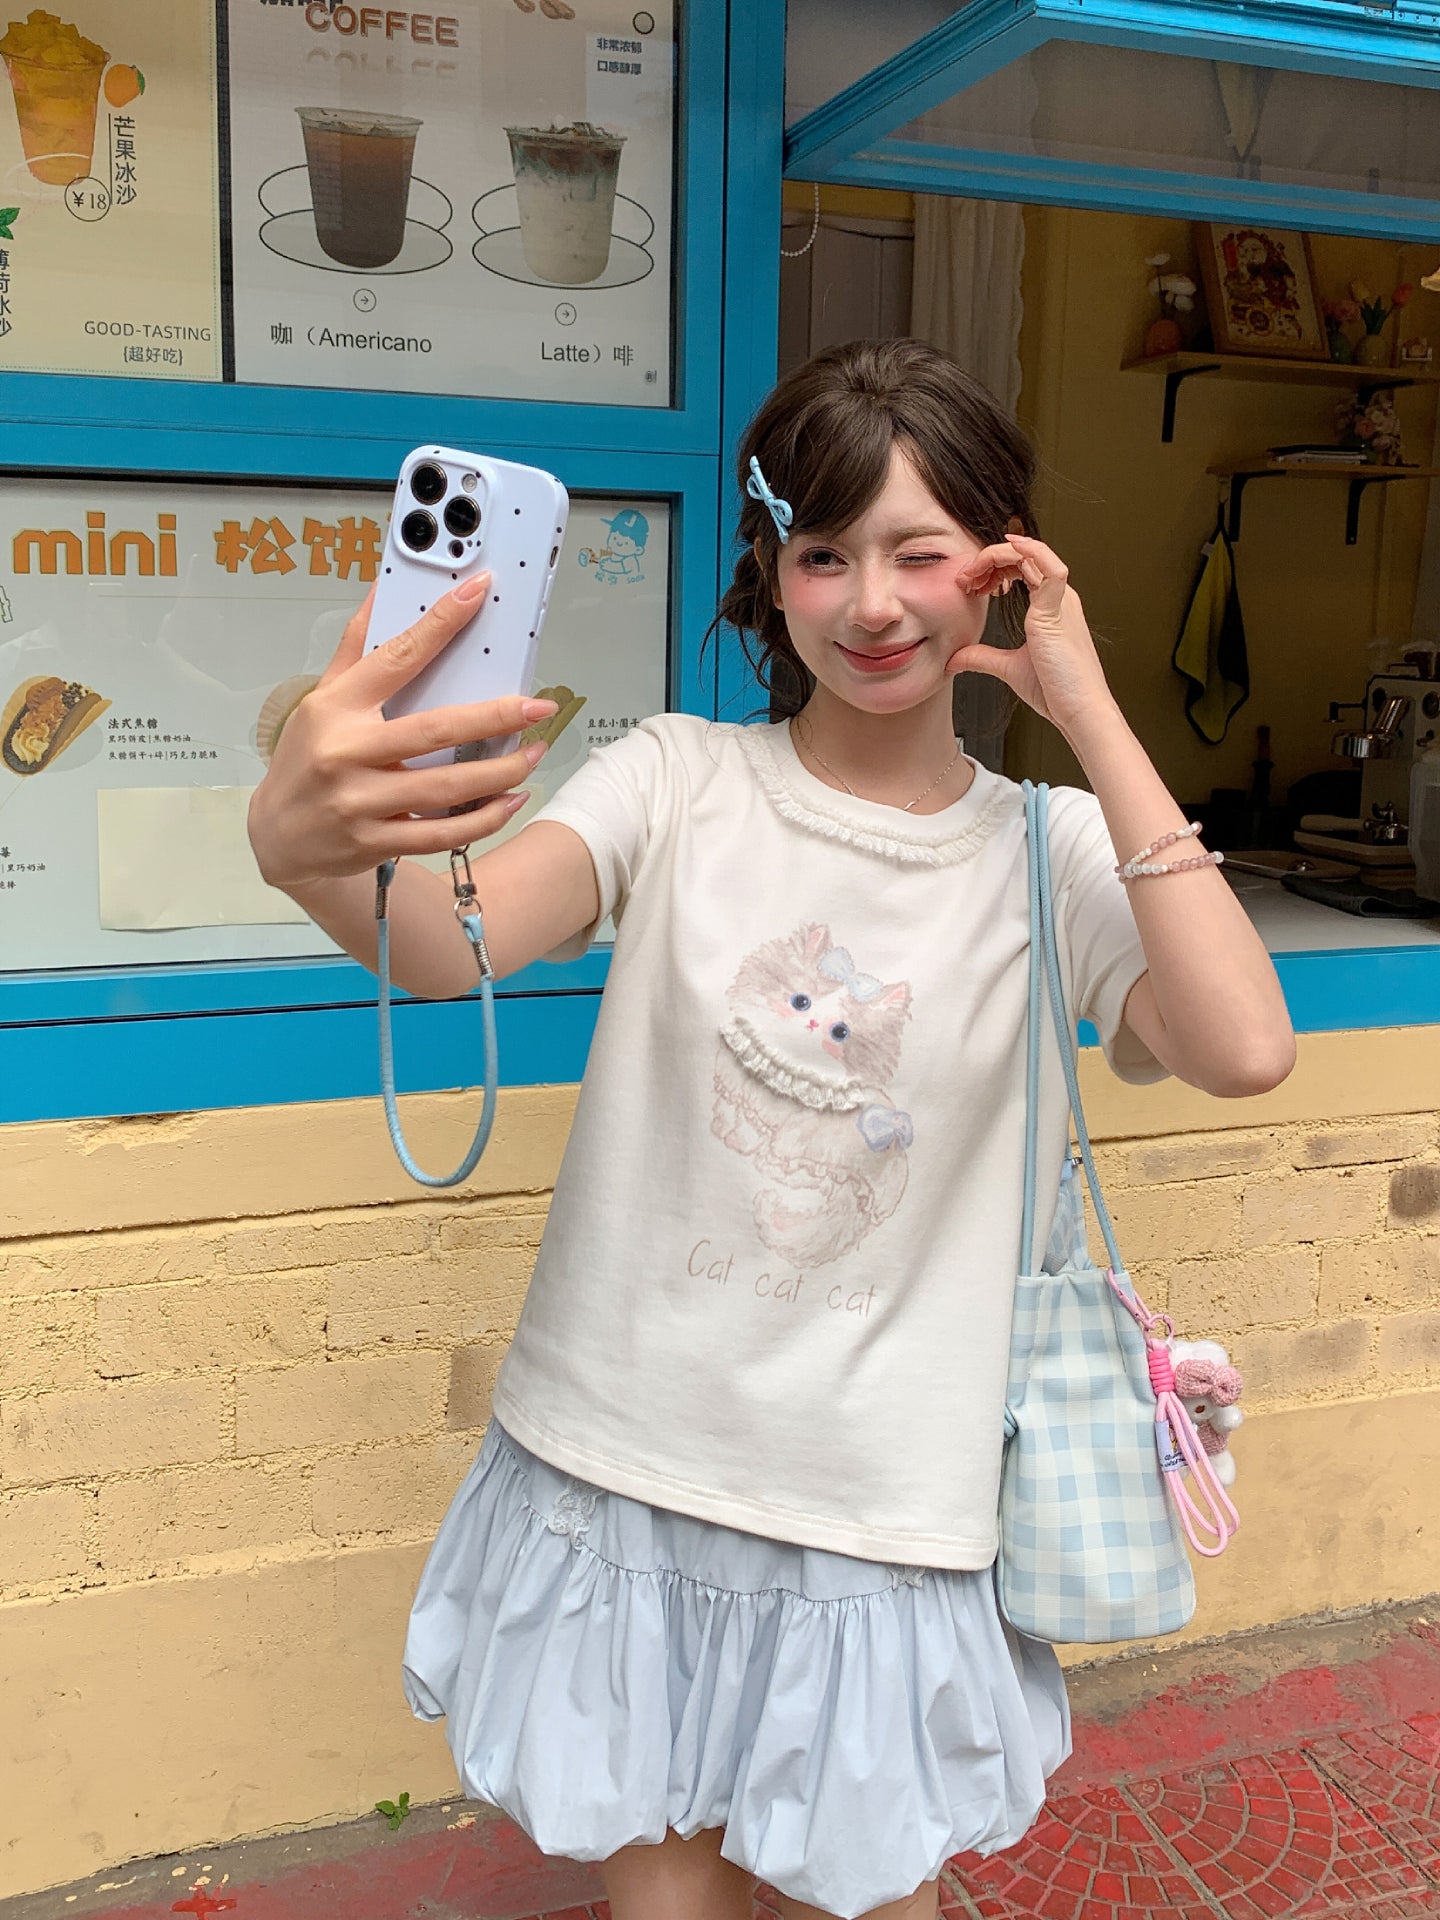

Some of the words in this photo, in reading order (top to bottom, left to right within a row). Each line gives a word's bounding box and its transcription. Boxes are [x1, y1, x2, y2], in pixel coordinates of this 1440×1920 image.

[305, 2, 460, 48] COFFEE
[597, 37, 642, 54] 非常浓郁
[597, 60, 642, 76] 口感醇厚
[114, 115, 137, 205] 芒果冰沙
[84, 320, 212, 342] GOOD-TASTING
[13, 511, 178, 577] mini
[214, 511, 391, 582] 松饼
[108, 718, 158, 730] 法式焦糖
[688, 1239, 734, 1285] Cat
[755, 1273, 804, 1303] cat
[827, 1284, 875, 1318] cat
